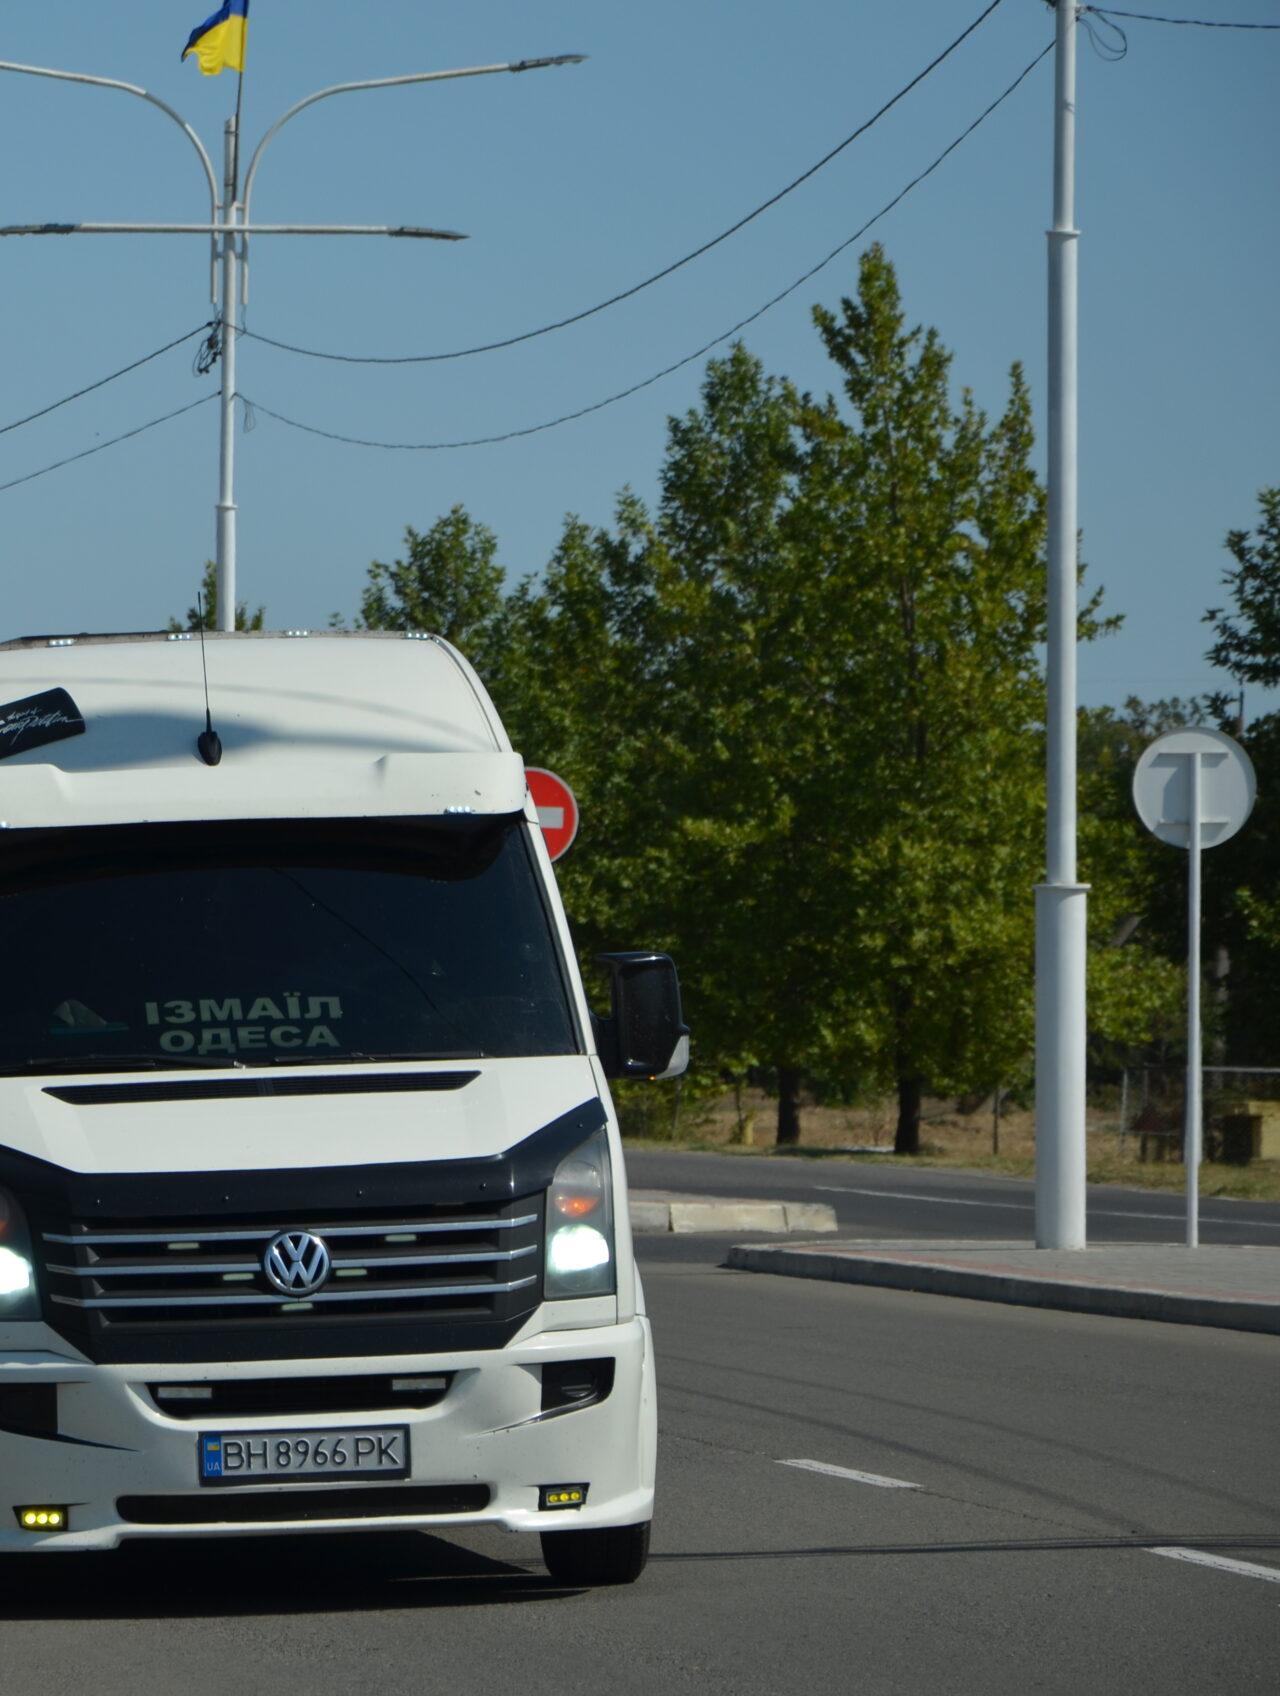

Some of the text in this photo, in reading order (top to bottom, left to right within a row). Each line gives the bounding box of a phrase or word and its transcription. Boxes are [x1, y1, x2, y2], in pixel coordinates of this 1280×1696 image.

[145, 991, 342, 1025] ІЗМАЇЛ
[160, 1024, 341, 1055] ОДЕСА
[275, 1437, 348, 1468] 8966
